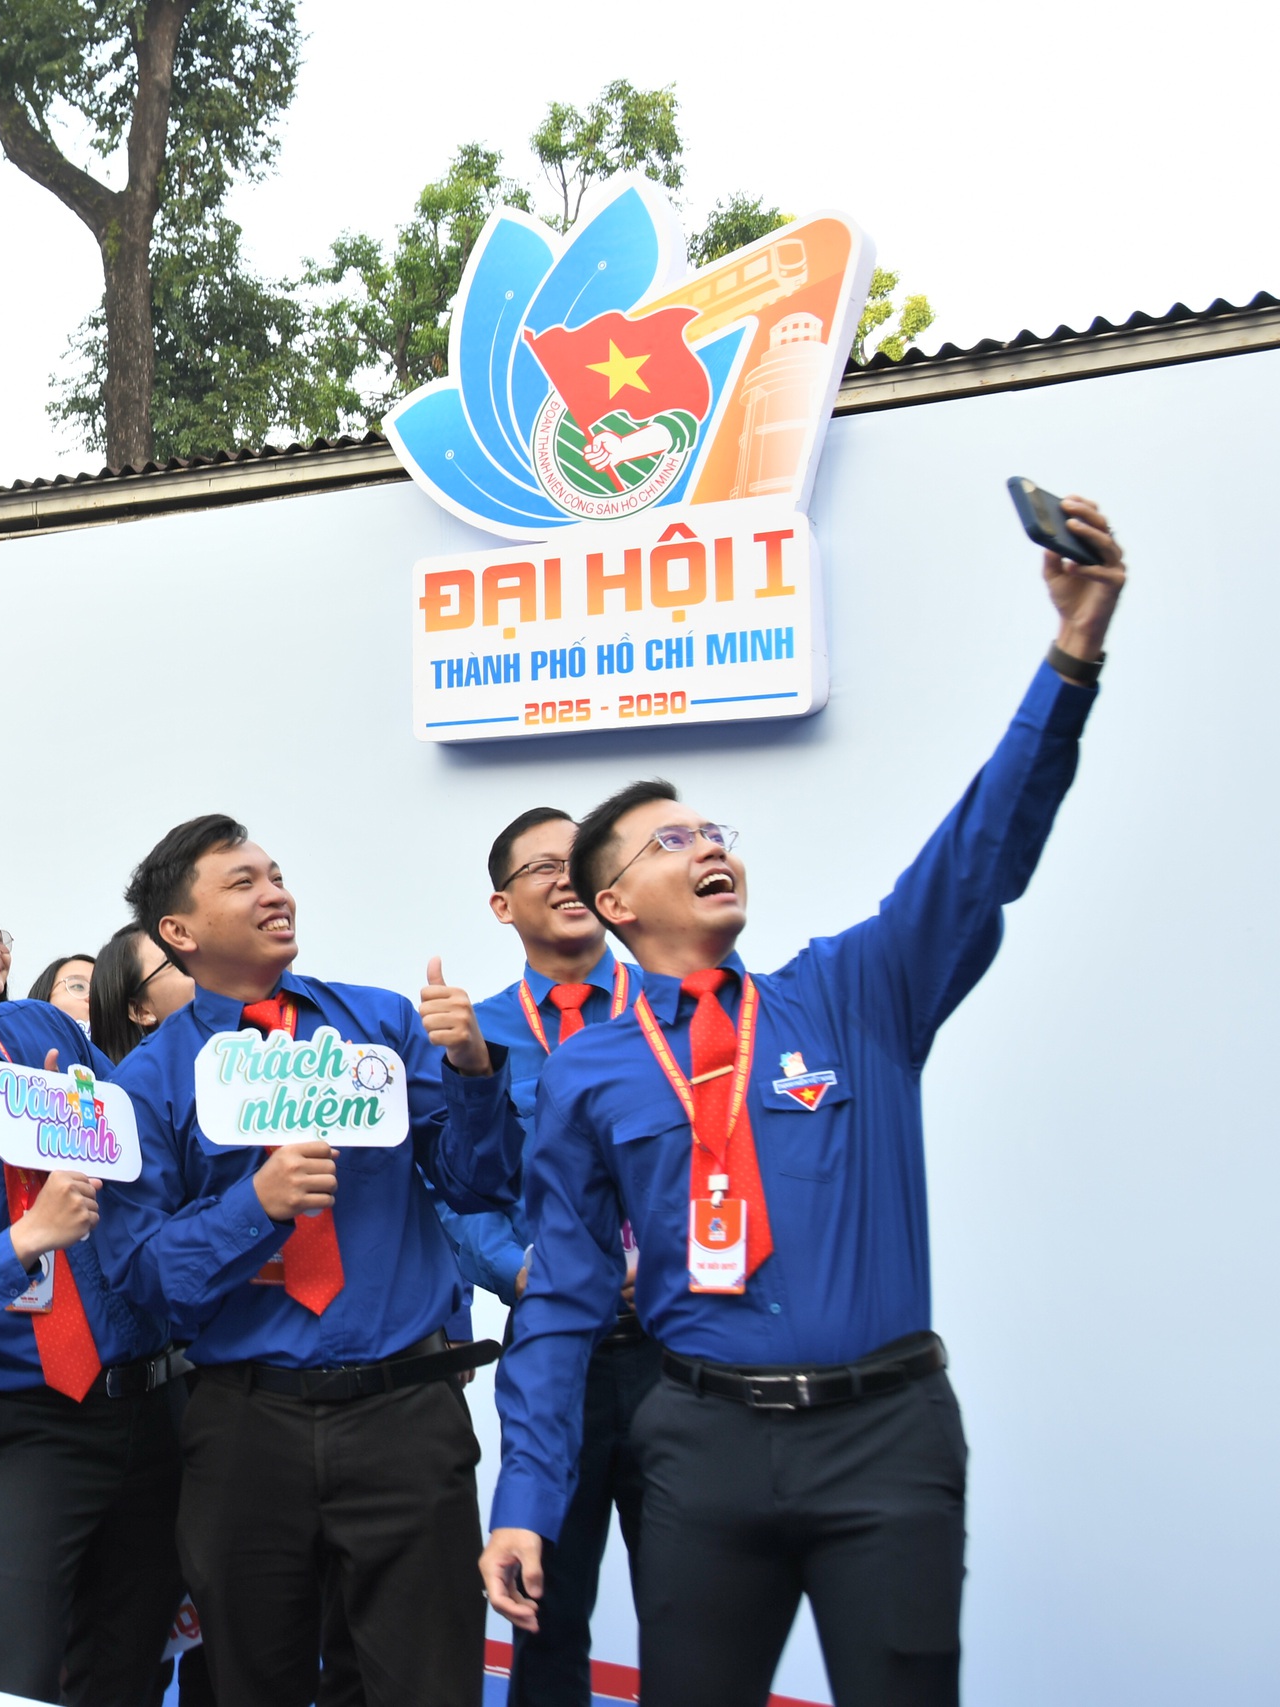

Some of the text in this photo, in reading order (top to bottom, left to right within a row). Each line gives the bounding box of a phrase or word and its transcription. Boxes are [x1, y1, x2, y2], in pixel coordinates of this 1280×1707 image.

[538, 400, 680, 515] ĐOÀN THANH NIÊN CỘNG SẢN HỒ CHÍ MINH
[419, 522, 796, 639] ĐẠI HỘI I
[430, 627, 794, 689] THÀNH PHỐ HỒ CHÍ MINH
[524, 698, 591, 726] 2025
[618, 691, 687, 719] 2030
[215, 1033, 350, 1085] Trách
[238, 1085, 386, 1137] nhiệm
[37, 1114, 122, 1163] minh
